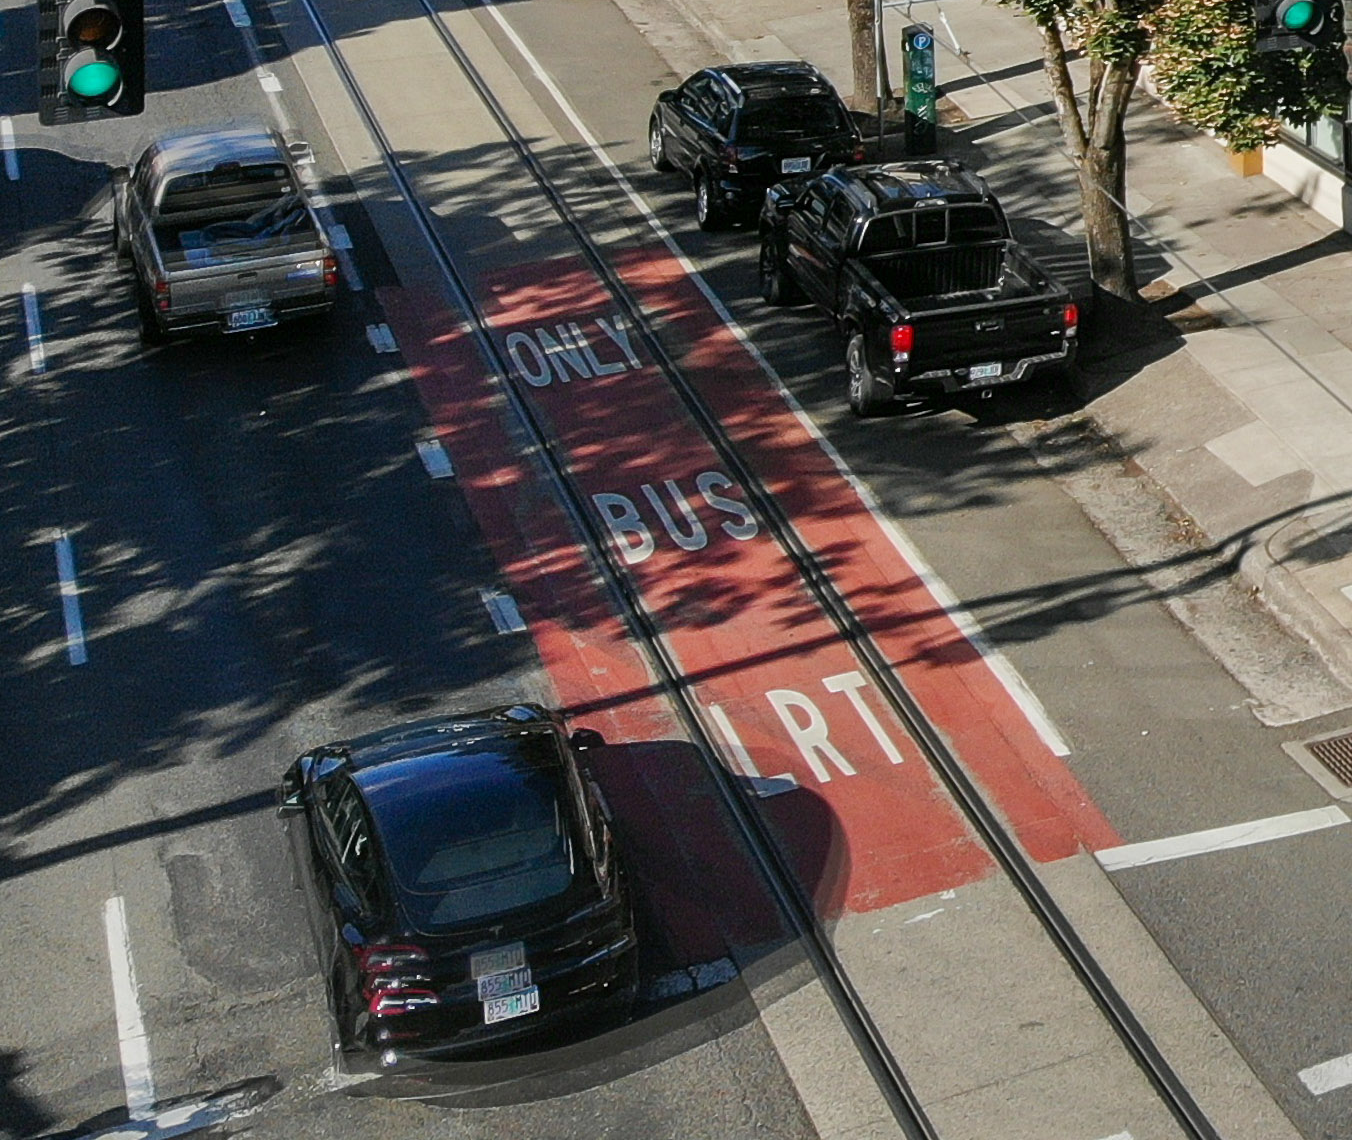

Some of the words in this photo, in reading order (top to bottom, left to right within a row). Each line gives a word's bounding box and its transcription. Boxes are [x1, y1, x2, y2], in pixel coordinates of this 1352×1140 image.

[505, 314, 643, 388] ONLY
[592, 471, 759, 565] BUS
[708, 670, 904, 798] LRT
[480, 977, 502, 994] 855
[487, 999, 509, 1016] 855
